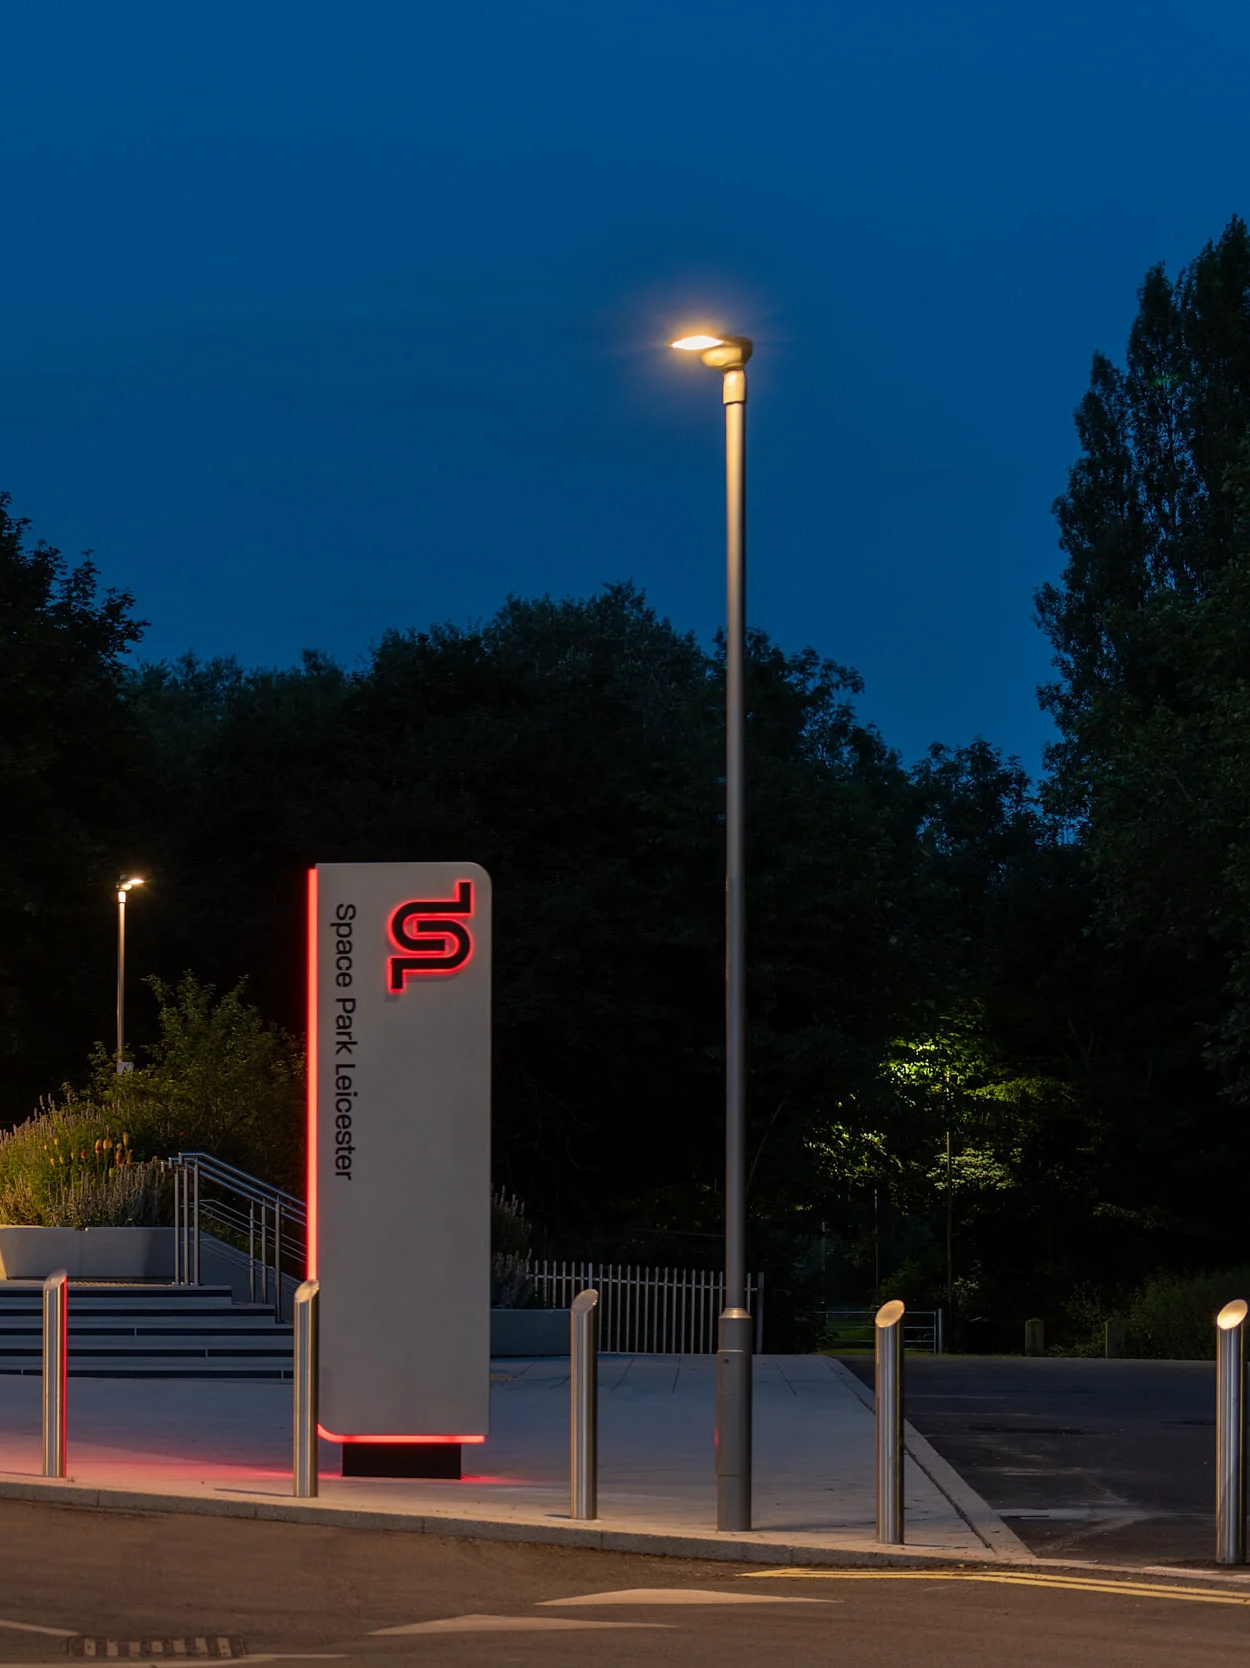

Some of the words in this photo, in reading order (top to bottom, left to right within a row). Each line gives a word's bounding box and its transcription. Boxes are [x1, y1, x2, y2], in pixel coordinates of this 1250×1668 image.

[330, 902, 357, 988] Space
[335, 997, 358, 1056] Park
[334, 1063, 358, 1181] Leicester
